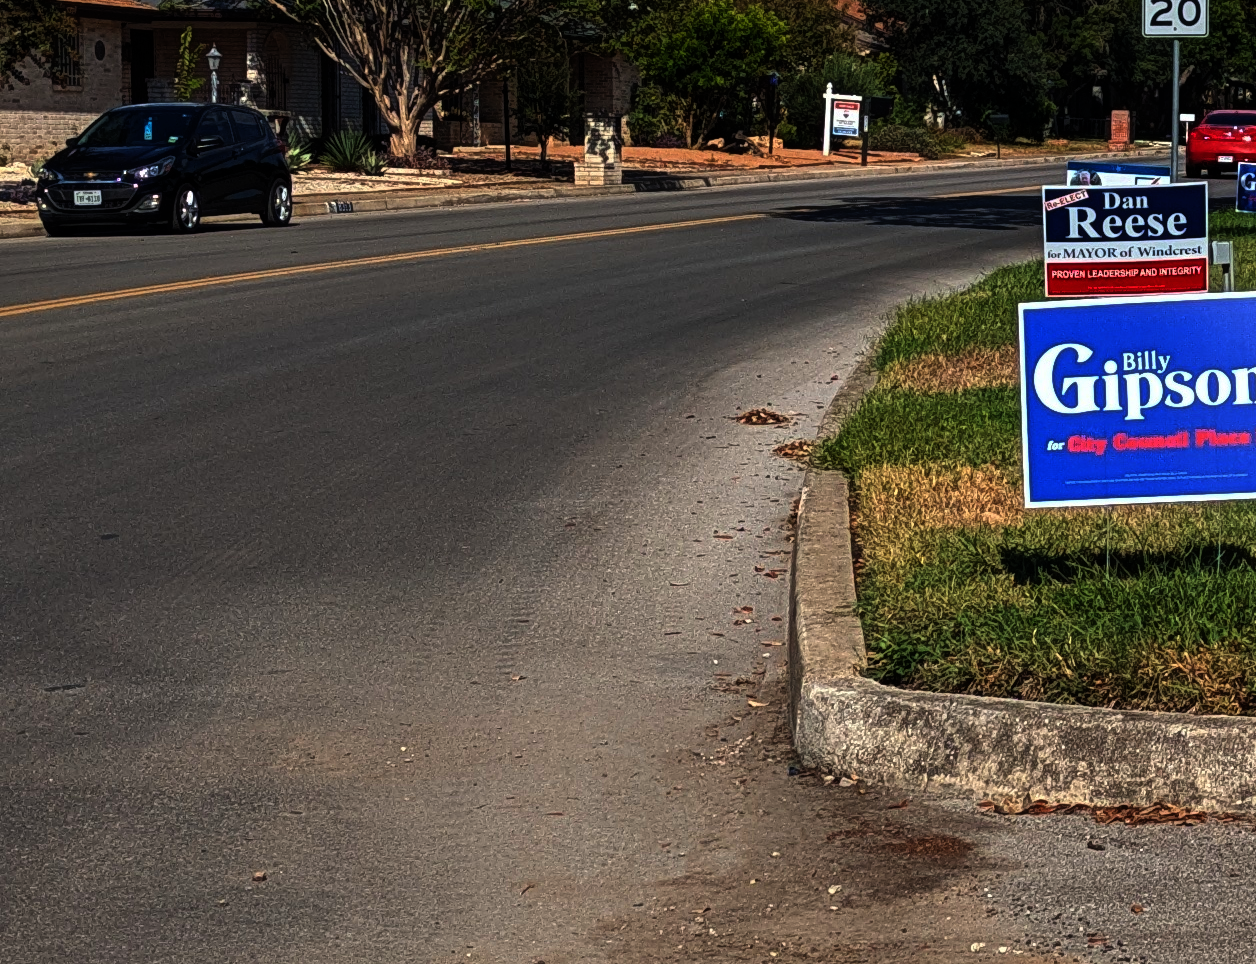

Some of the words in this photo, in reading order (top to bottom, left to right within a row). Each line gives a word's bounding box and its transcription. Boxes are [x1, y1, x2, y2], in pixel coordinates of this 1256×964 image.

[1102, 192, 1149, 210] Dan
[1065, 207, 1188, 239] Reese
[1047, 250, 1062, 259] for
[1063, 248, 1118, 259] MAYOR
[1119, 246, 1134, 258] of
[1137, 244, 1203, 257] Windcrest
[1051, 270, 1086, 279] PROVEN
[1087, 268, 1139, 279] LEADERSHIP
[1139, 268, 1158, 277] AND
[1159, 266, 1203, 276] INTEGRITY
[1122, 351, 1171, 374] Billy
[1046, 440, 1065, 451] for
[1067, 435, 1107, 456] City
[1112, 431, 1189, 451] Council
[1194, 428, 1251, 447] Place
